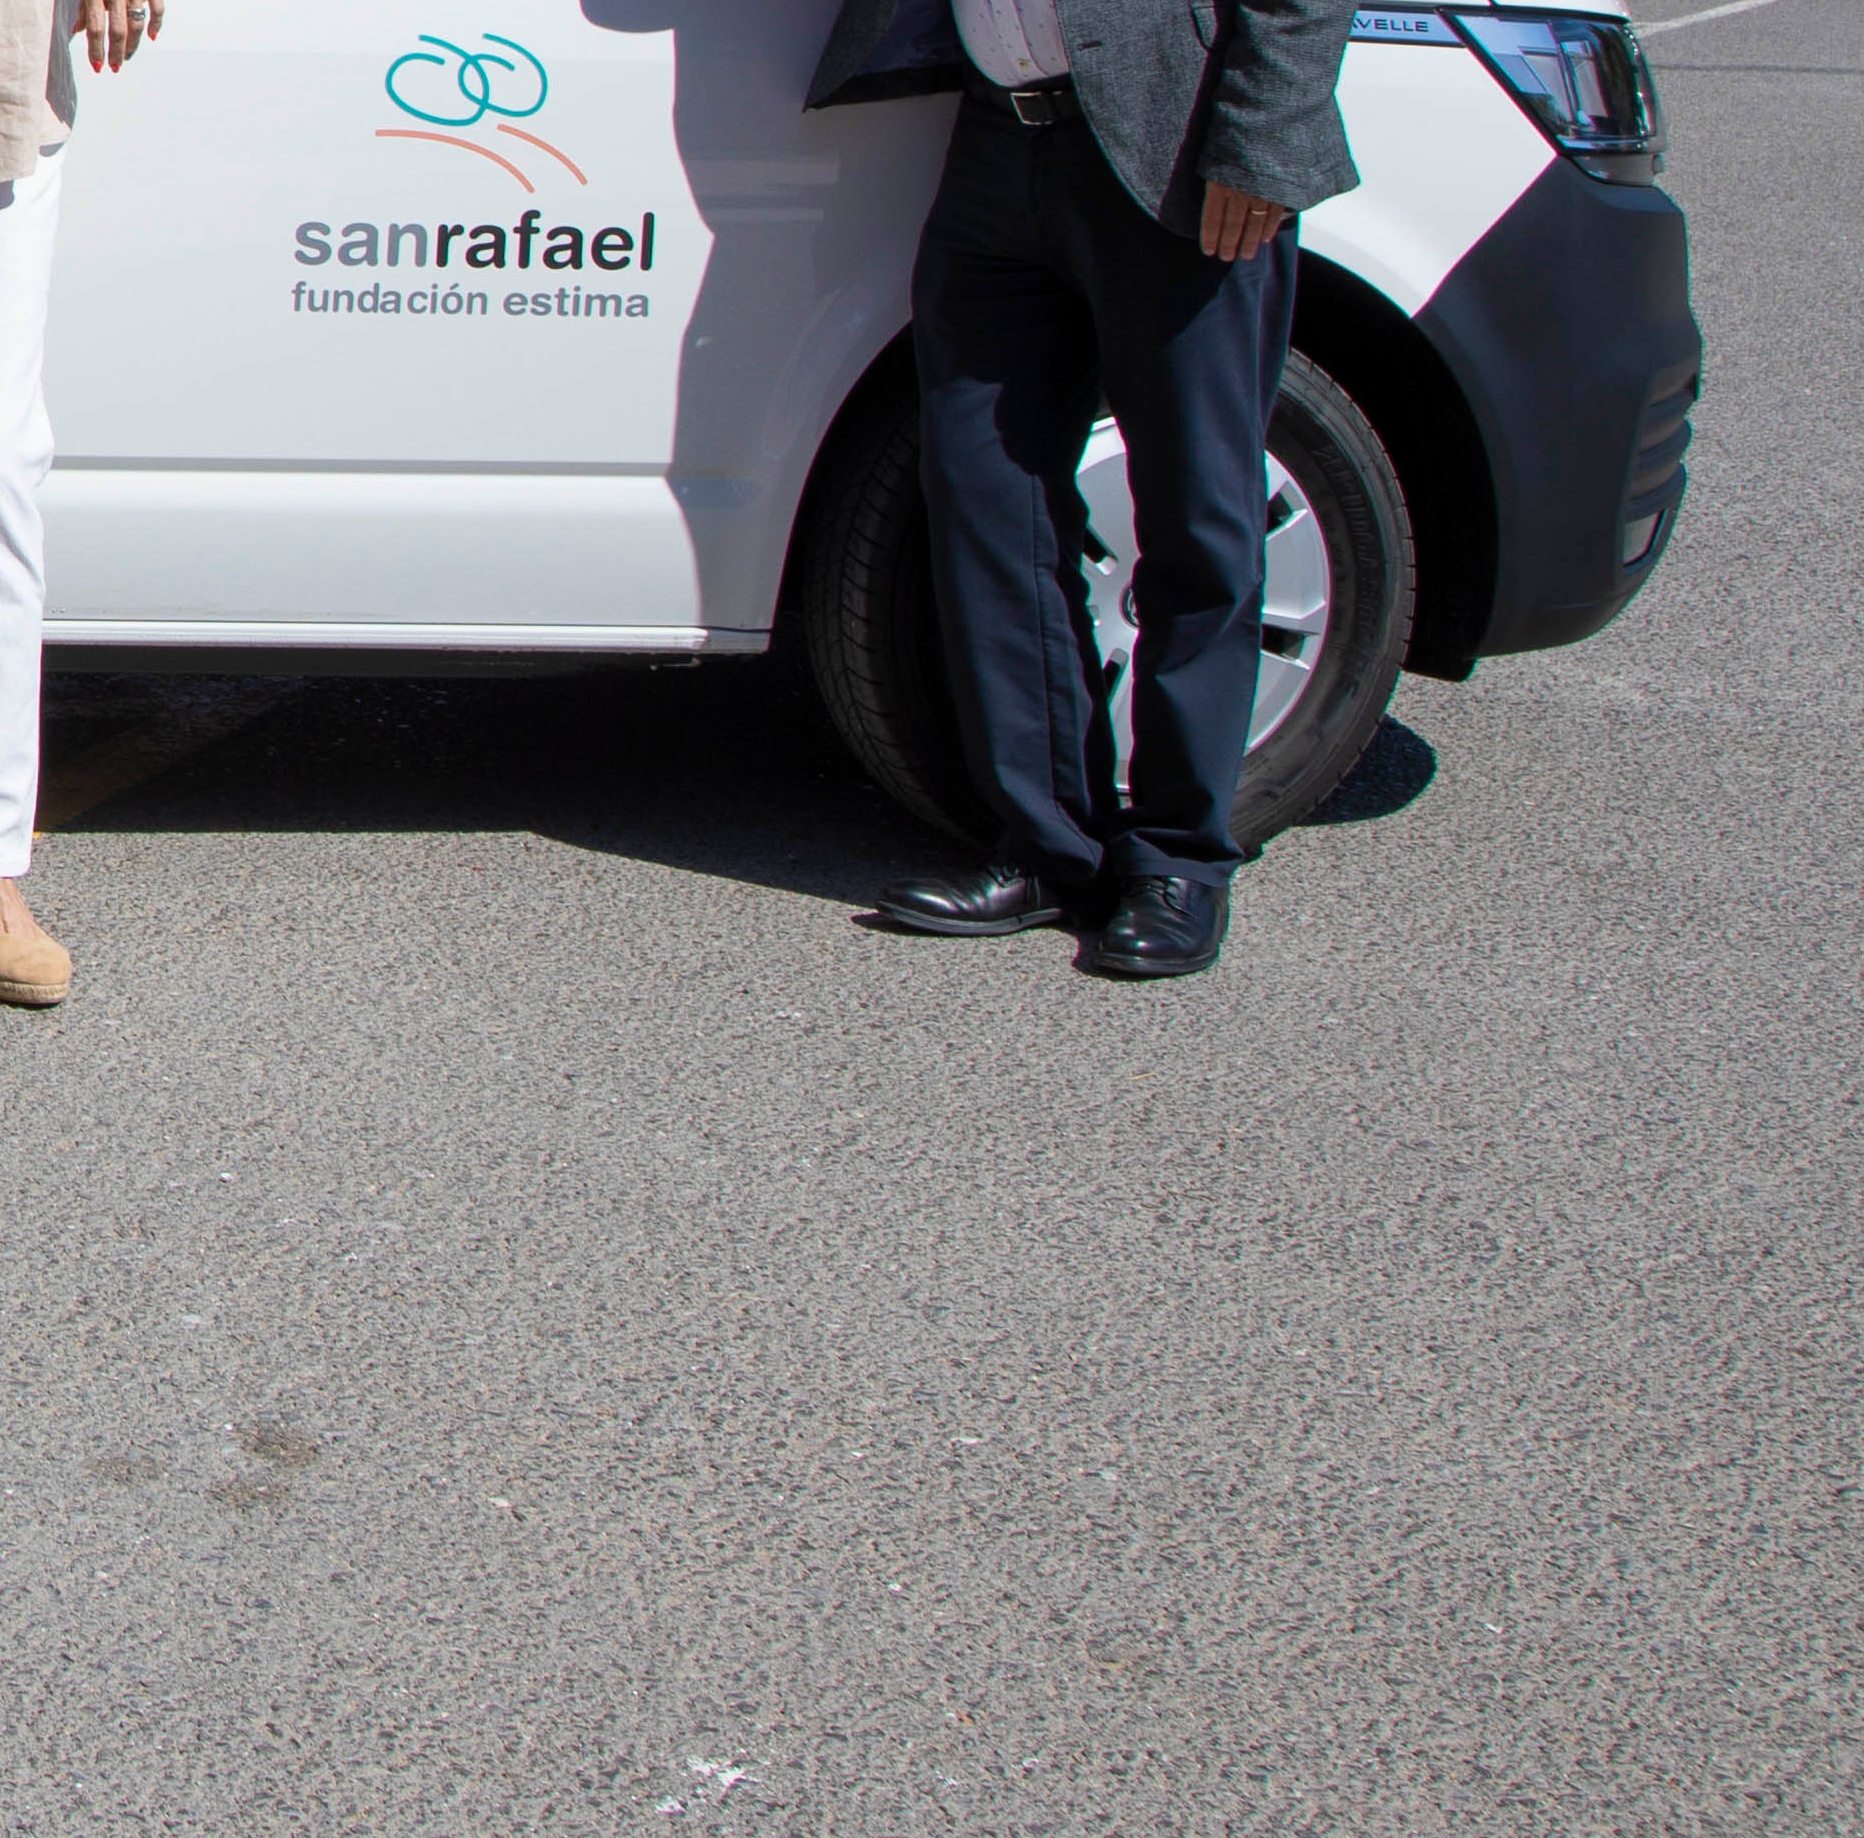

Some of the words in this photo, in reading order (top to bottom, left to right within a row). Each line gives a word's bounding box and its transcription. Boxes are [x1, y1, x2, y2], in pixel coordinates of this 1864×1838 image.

[294, 209, 655, 271] sanrafael
[291, 281, 489, 316] fundación
[503, 286, 650, 318] estima
